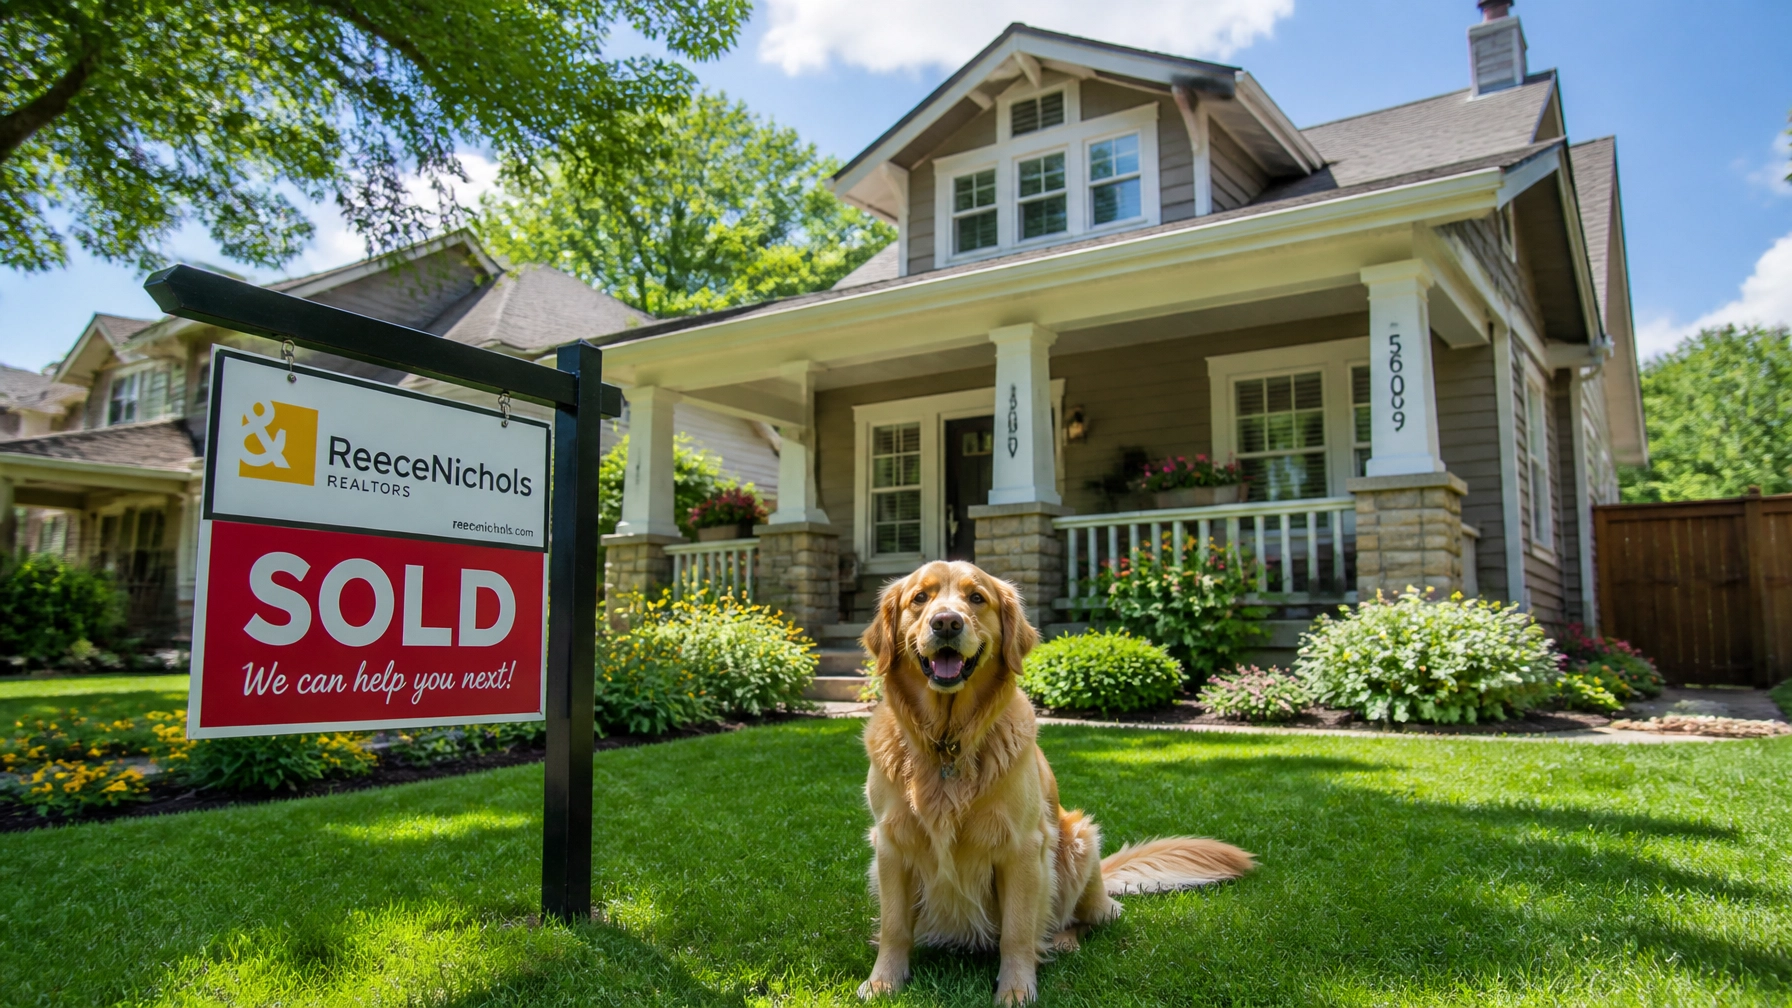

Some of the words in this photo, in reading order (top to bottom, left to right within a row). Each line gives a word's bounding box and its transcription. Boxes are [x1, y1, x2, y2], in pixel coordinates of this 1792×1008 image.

[238, 398, 292, 469] &
[327, 474, 411, 498] REALTORS
[328, 435, 532, 497] ReeceNichols
[243, 551, 516, 647] SOLD
[242, 661, 288, 696] We
[297, 673, 347, 695] can
[353, 659, 407, 706] help
[411, 672, 456, 705] you
[461, 660, 518, 689] next!
